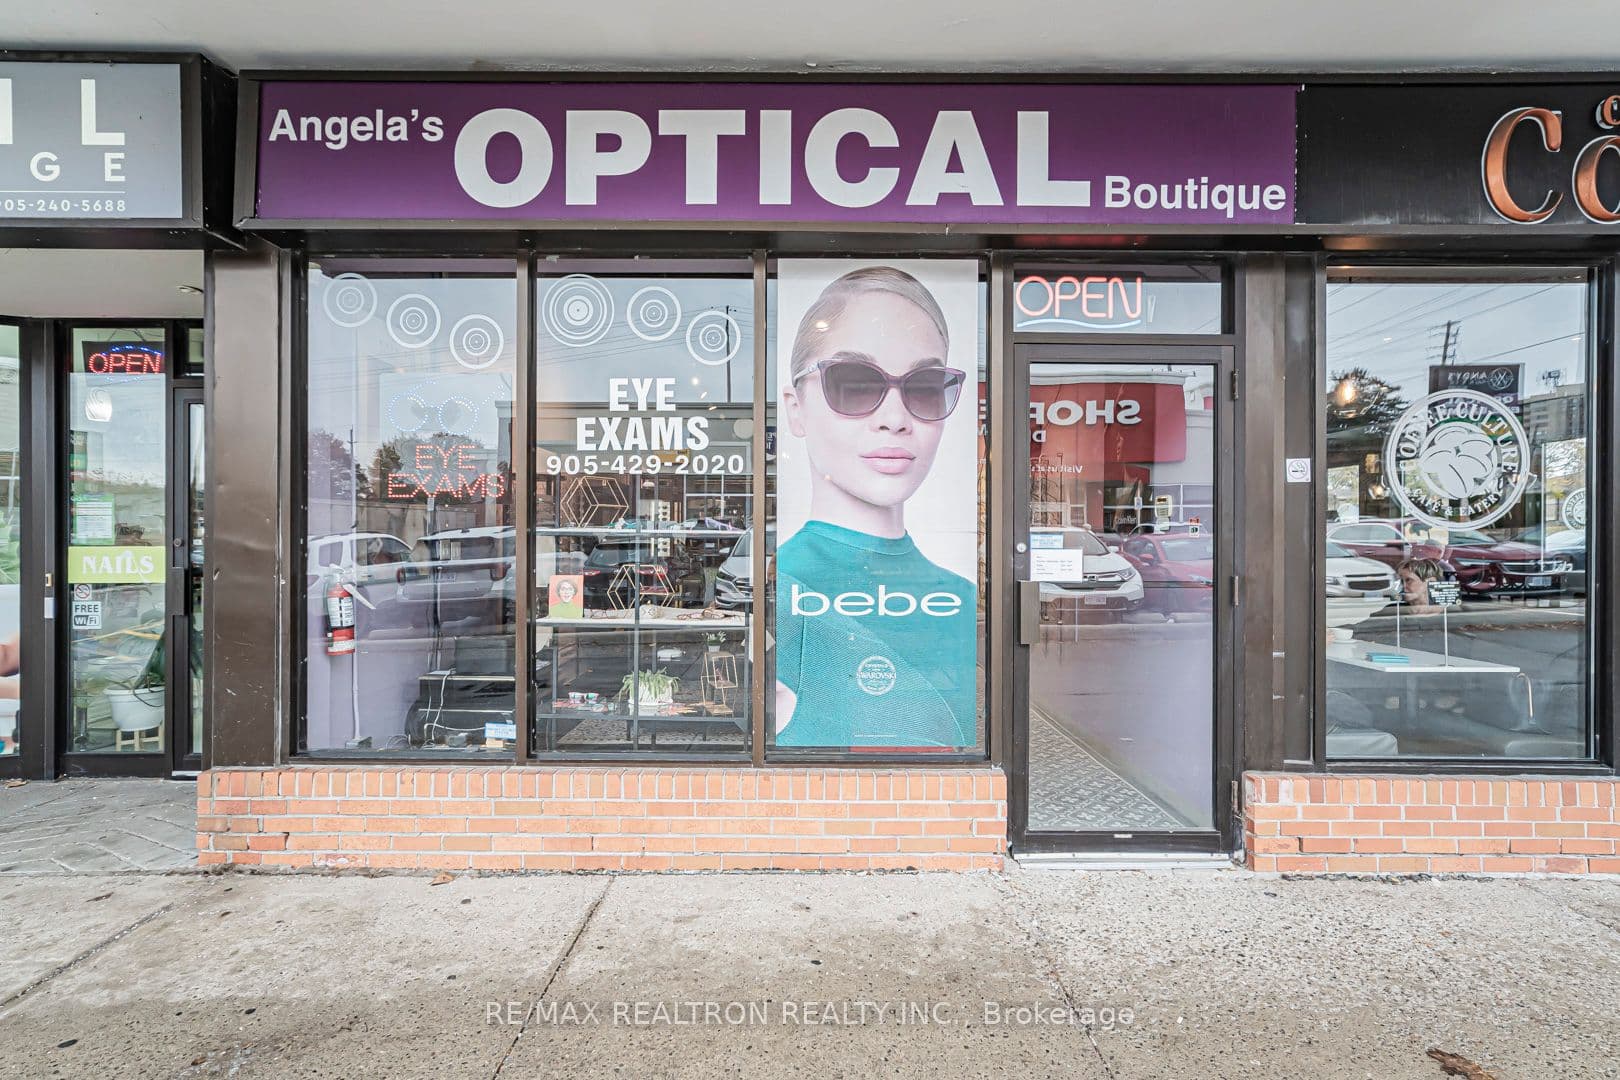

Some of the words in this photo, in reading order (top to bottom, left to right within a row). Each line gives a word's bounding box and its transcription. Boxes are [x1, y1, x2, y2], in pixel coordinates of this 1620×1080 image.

[269, 108, 444, 150] Angela's
[454, 107, 1091, 208] OPTICAL
[1105, 175, 1287, 218] Boutique
[0, 199, 126, 212] 05-240-5688
[1016, 275, 1143, 319] OPEN
[88, 353, 161, 375] OPEN
[609, 377, 677, 412] EYE
[577, 416, 710, 452] EXAMS
[1456, 400, 1520, 474] CULTURE
[415, 444, 476, 470] EYE
[546, 454, 745, 476] 905-429-2020
[387, 472, 506, 499] EXAMS
[82, 554, 155, 575] NAILS
[74, 604, 99, 613] FREE
[791, 584, 962, 617] bebe
